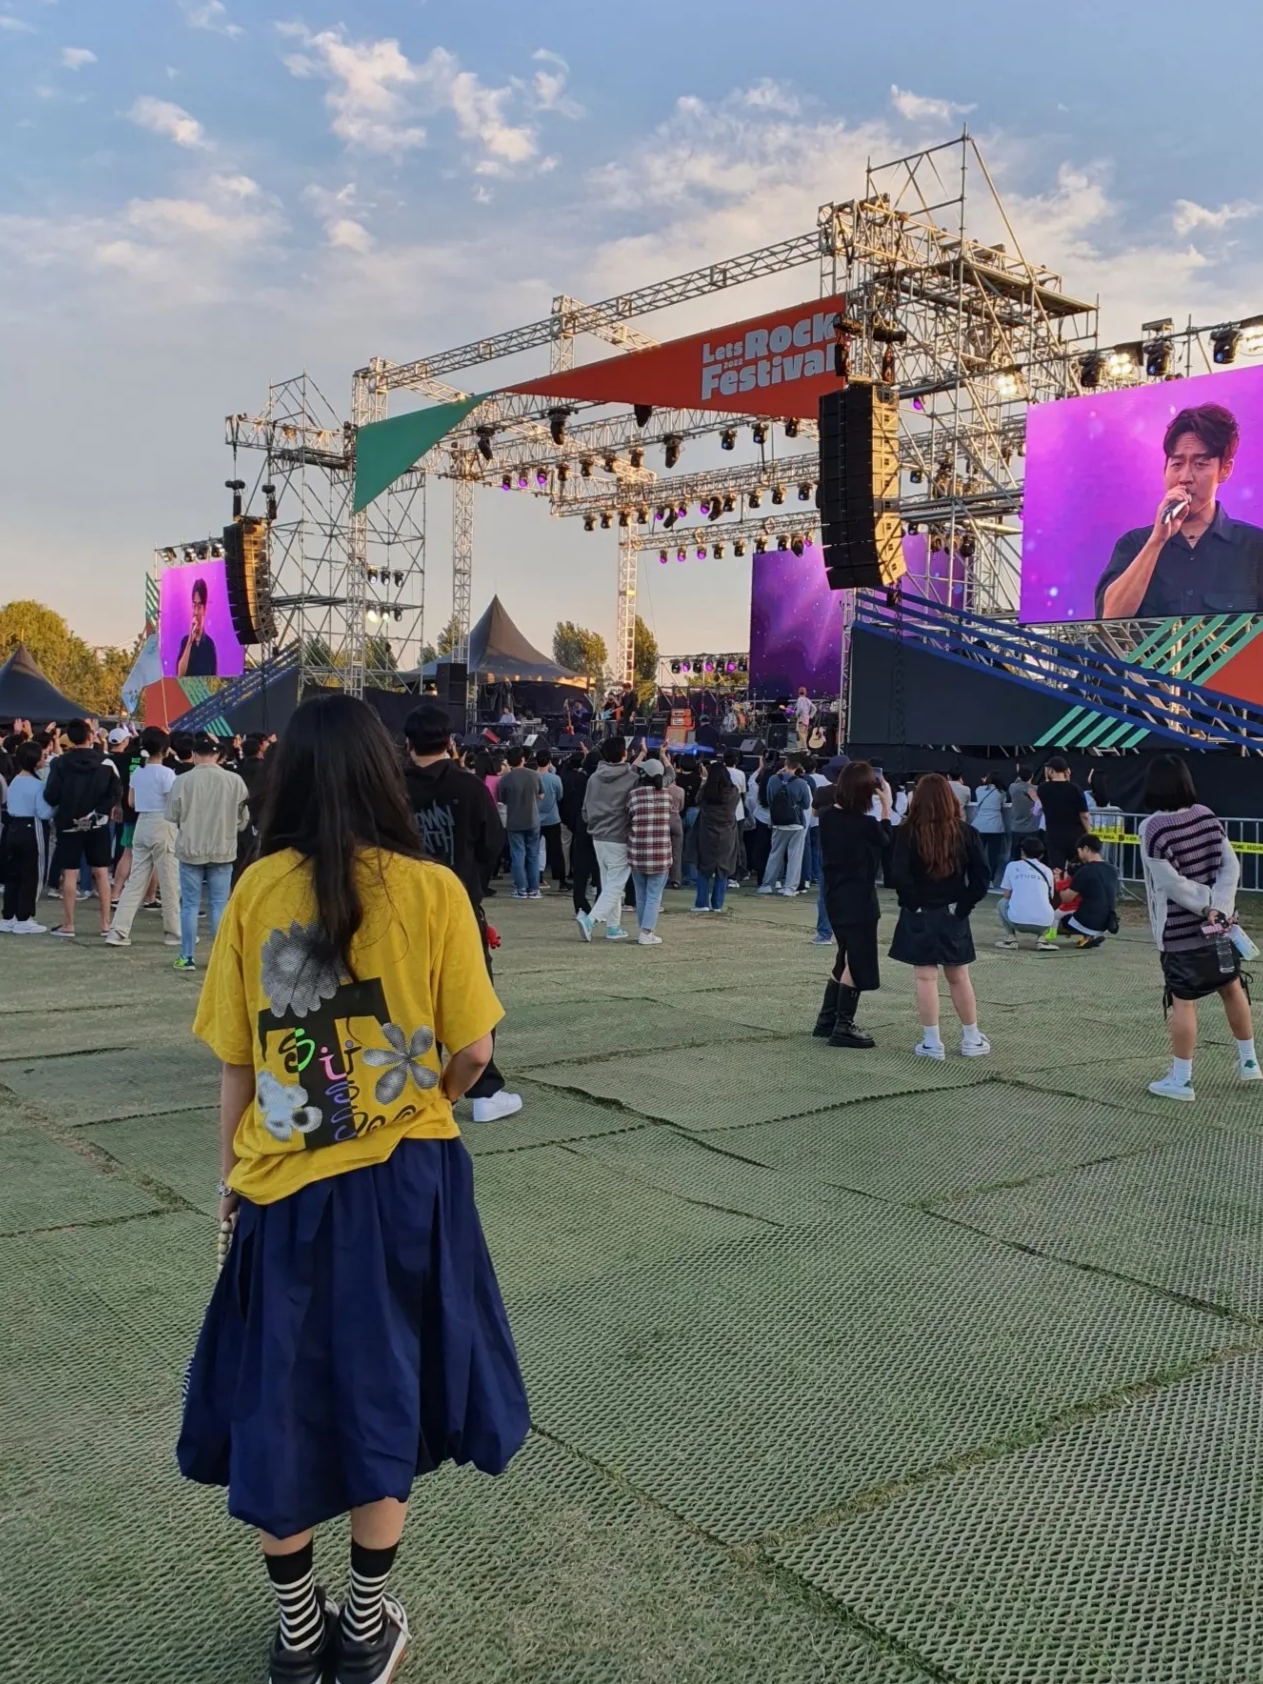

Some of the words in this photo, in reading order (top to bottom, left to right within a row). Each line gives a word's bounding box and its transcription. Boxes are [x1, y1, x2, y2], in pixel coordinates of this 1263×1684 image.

[703, 342, 744, 363] Lets
[745, 312, 837, 360] ROCK
[701, 343, 836, 400] Festival
